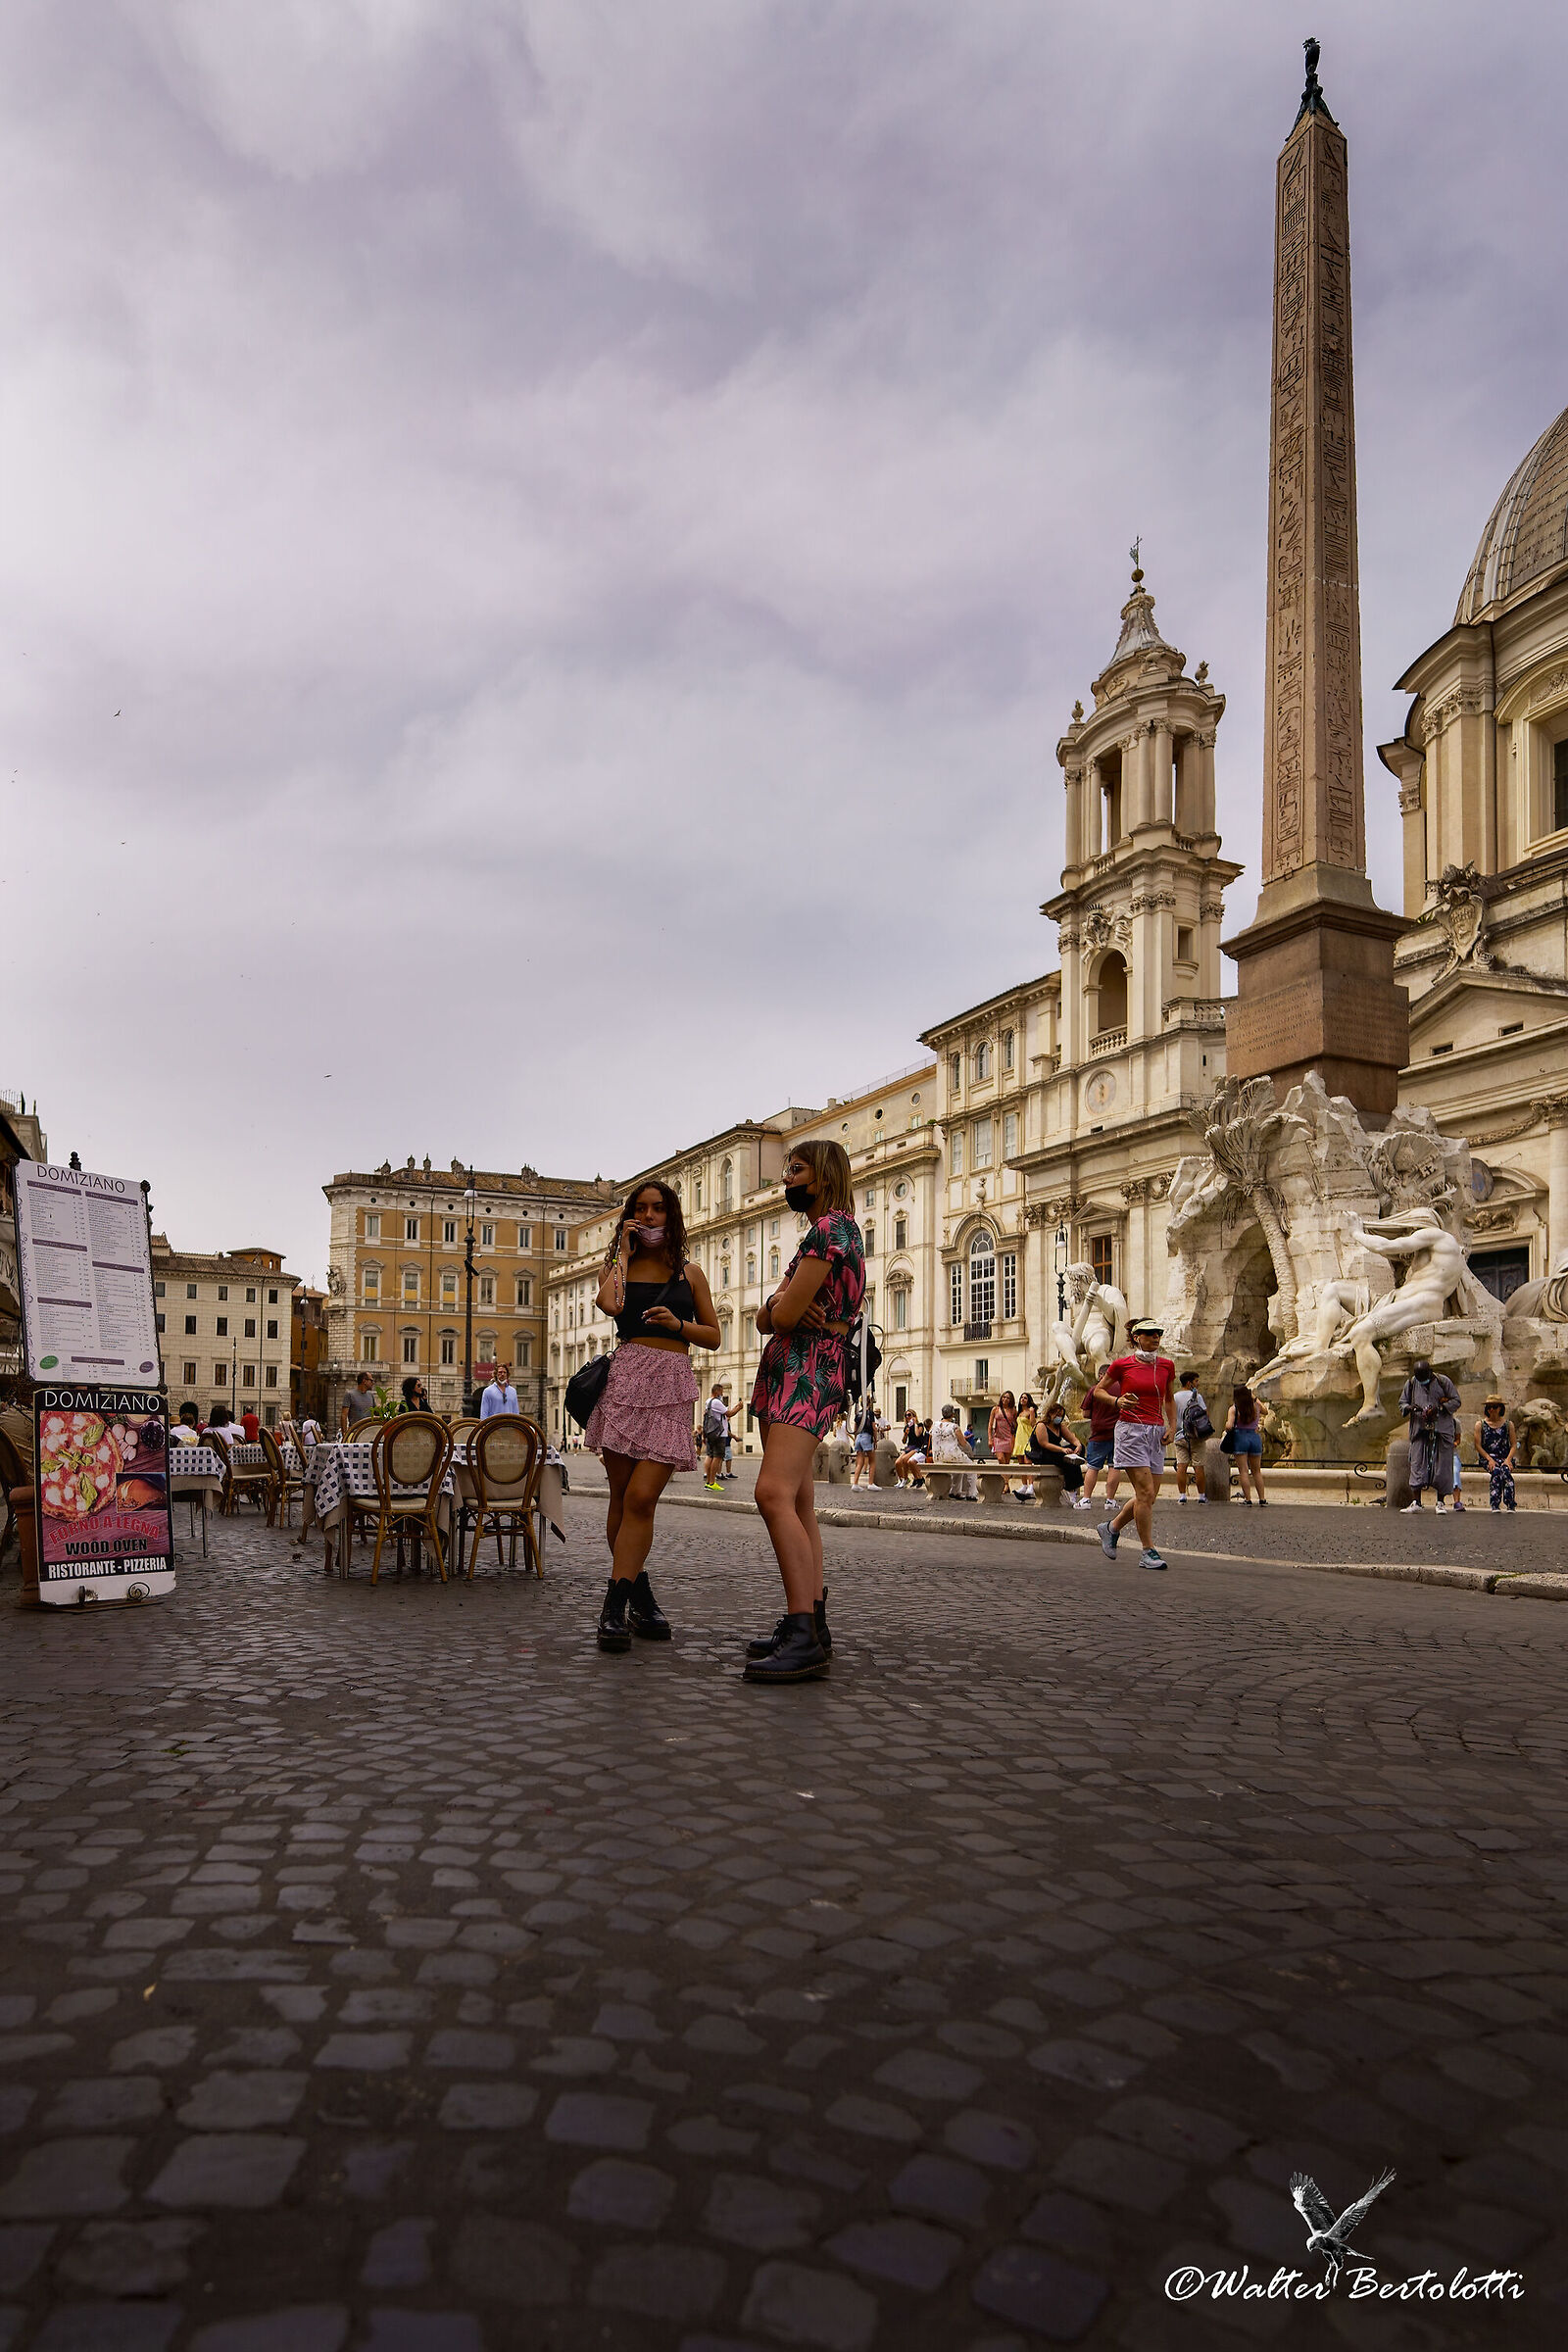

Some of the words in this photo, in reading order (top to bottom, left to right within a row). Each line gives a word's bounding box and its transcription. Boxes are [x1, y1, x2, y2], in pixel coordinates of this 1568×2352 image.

[37, 1164, 125, 1194] DOMIZIANO
[44, 1391, 160, 1412] DOMIZIANO
[49, 1515, 102, 1545] FORNO
[103, 1514, 113, 1529] A
[116, 1515, 161, 1540] LEGNA
[65, 1540, 110, 1556] WOOD
[113, 1538, 148, 1552] OVEN
[48, 1561, 116, 1579] RISTORANTE
[123, 1556, 167, 1572] PIZZERIA
